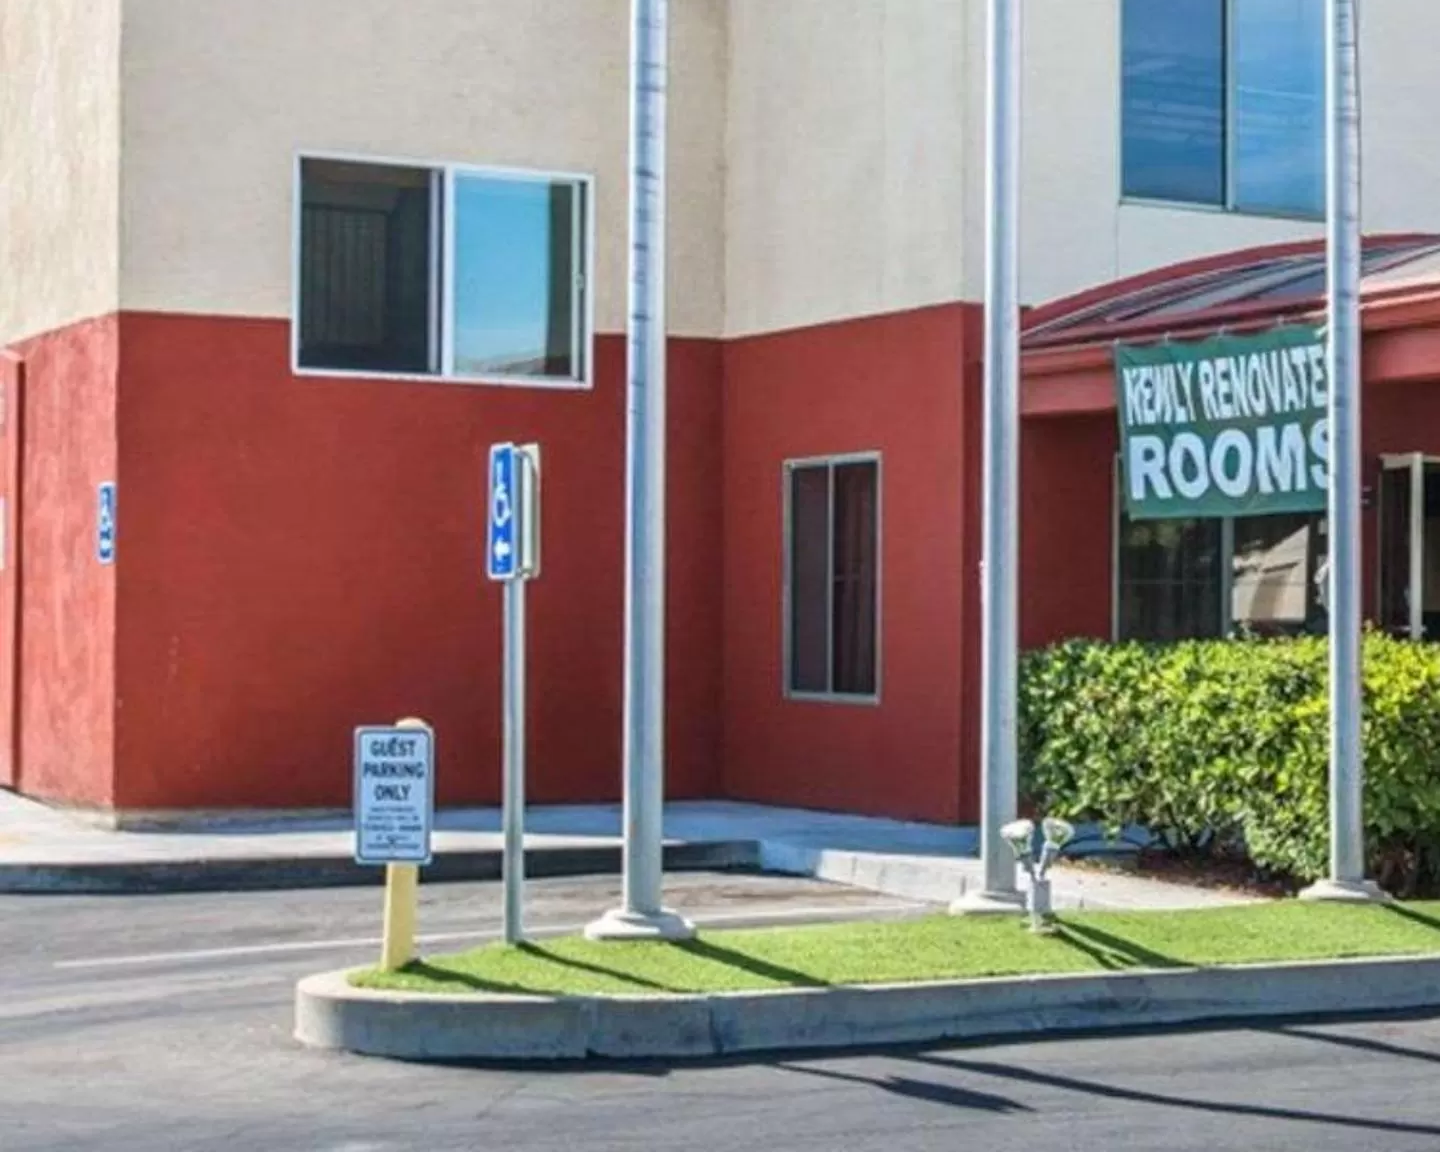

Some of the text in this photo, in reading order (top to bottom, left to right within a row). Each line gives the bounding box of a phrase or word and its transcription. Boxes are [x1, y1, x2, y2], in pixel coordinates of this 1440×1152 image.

[1123, 344, 1330, 425] NEWLY RENOVATE
[370, 738, 416, 757] GUEST
[363, 761, 425, 779] PARKING
[374, 783, 411, 801] ONLY
